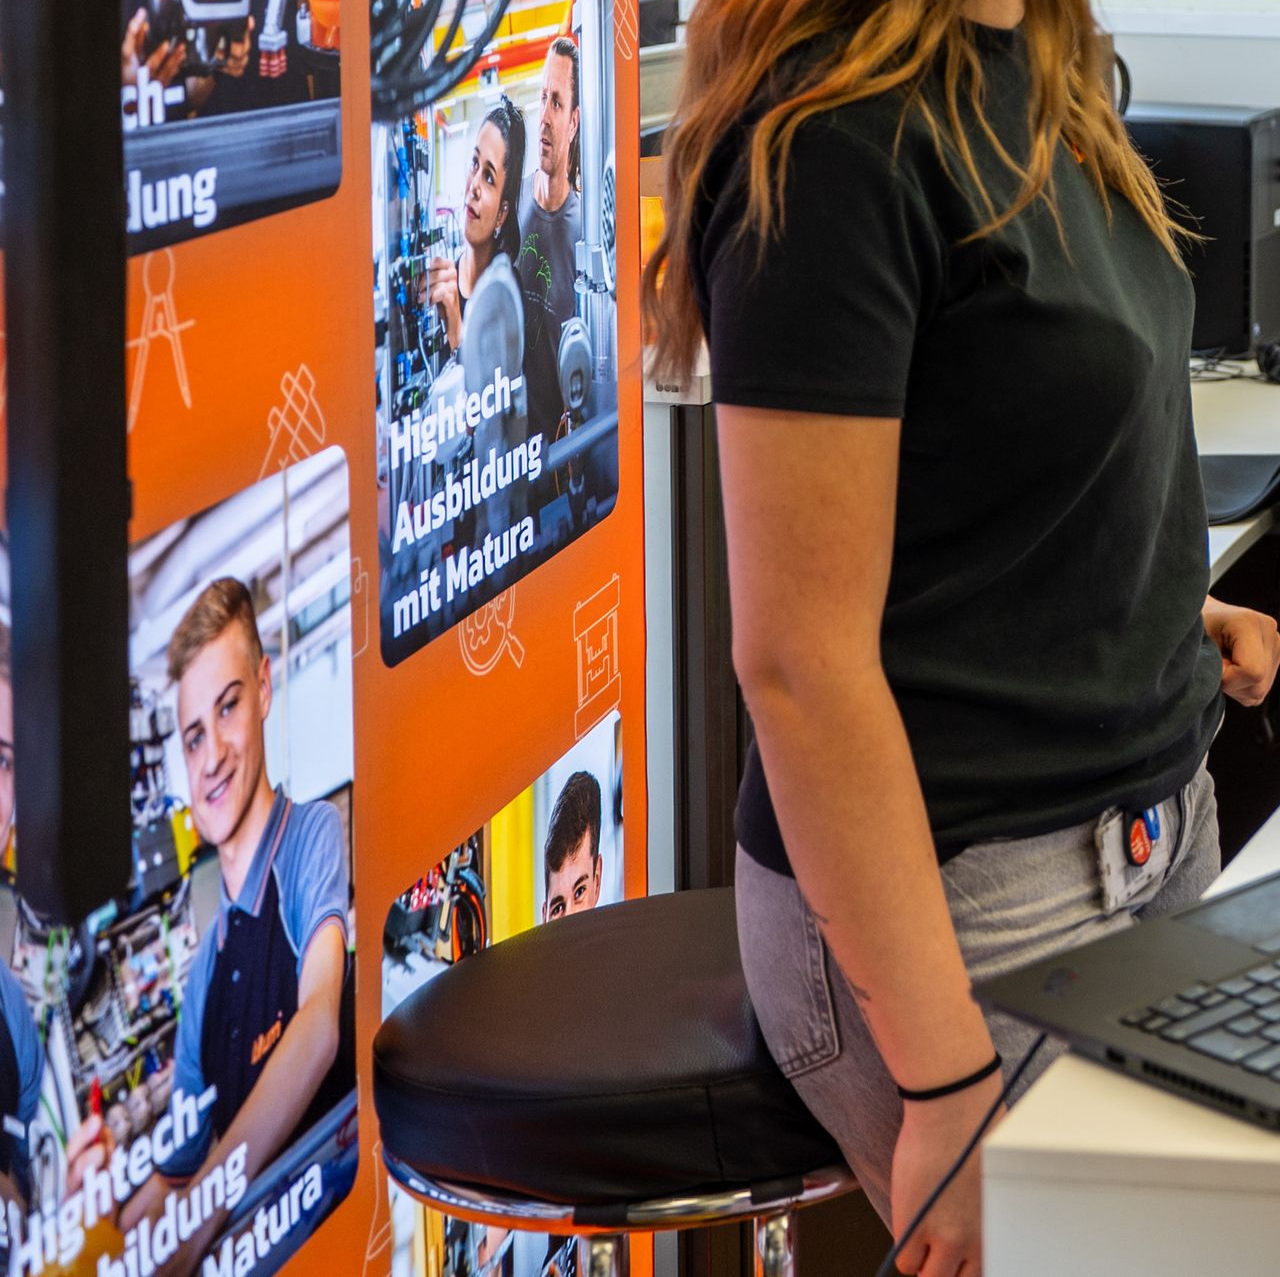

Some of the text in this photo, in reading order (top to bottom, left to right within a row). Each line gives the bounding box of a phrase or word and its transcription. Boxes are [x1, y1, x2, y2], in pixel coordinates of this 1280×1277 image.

[391, 367, 523, 470] Hightech-
[393, 432, 543, 554] Ausbildung
[393, 515, 534, 638] mit Matura
[8, 1085, 217, 1277] Hightech-
[202, 1163, 322, 1277] Matura
